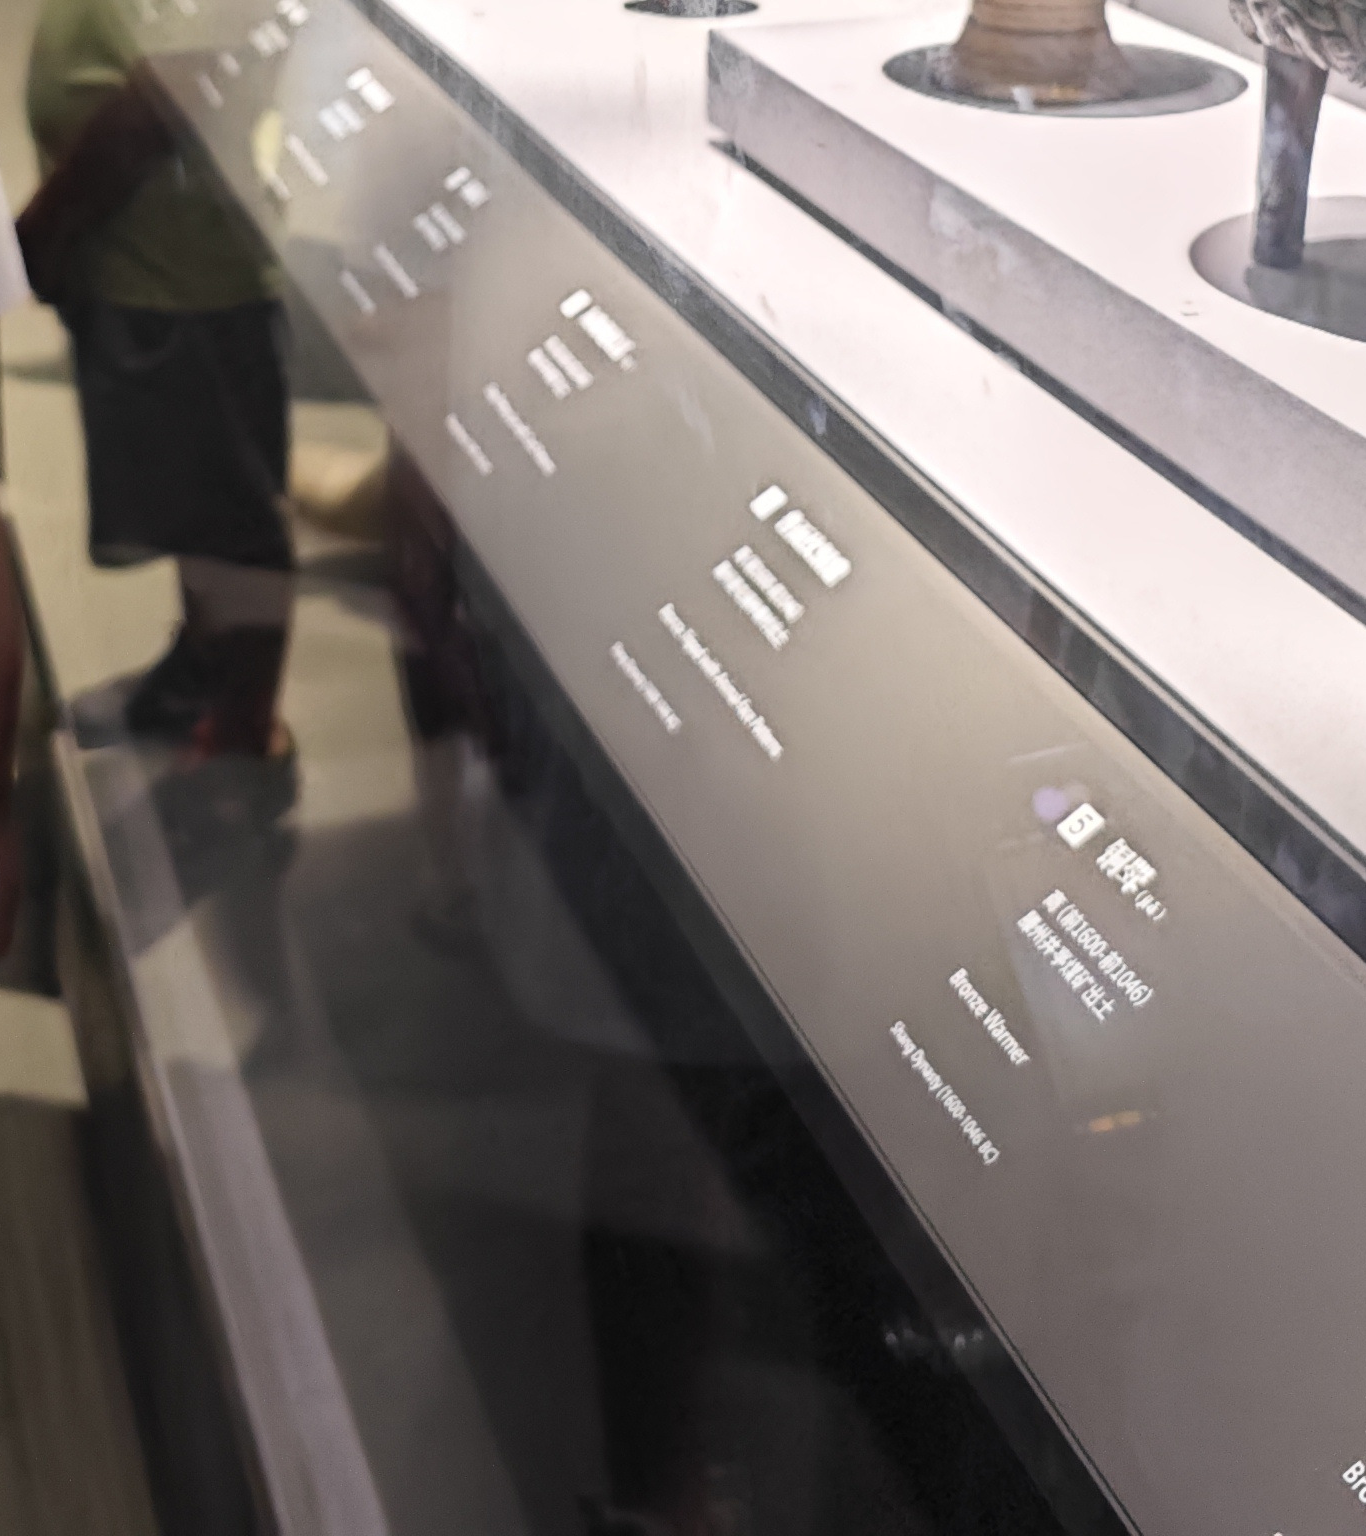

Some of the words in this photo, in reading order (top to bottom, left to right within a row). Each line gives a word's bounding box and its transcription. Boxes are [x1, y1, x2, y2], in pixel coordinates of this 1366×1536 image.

[889, 1020, 917, 1056] Shang
[910, 1048, 943, 1094] Dynasty
[948, 967, 989, 1019] Bronze
[982, 1007, 1031, 1066] Warmer
